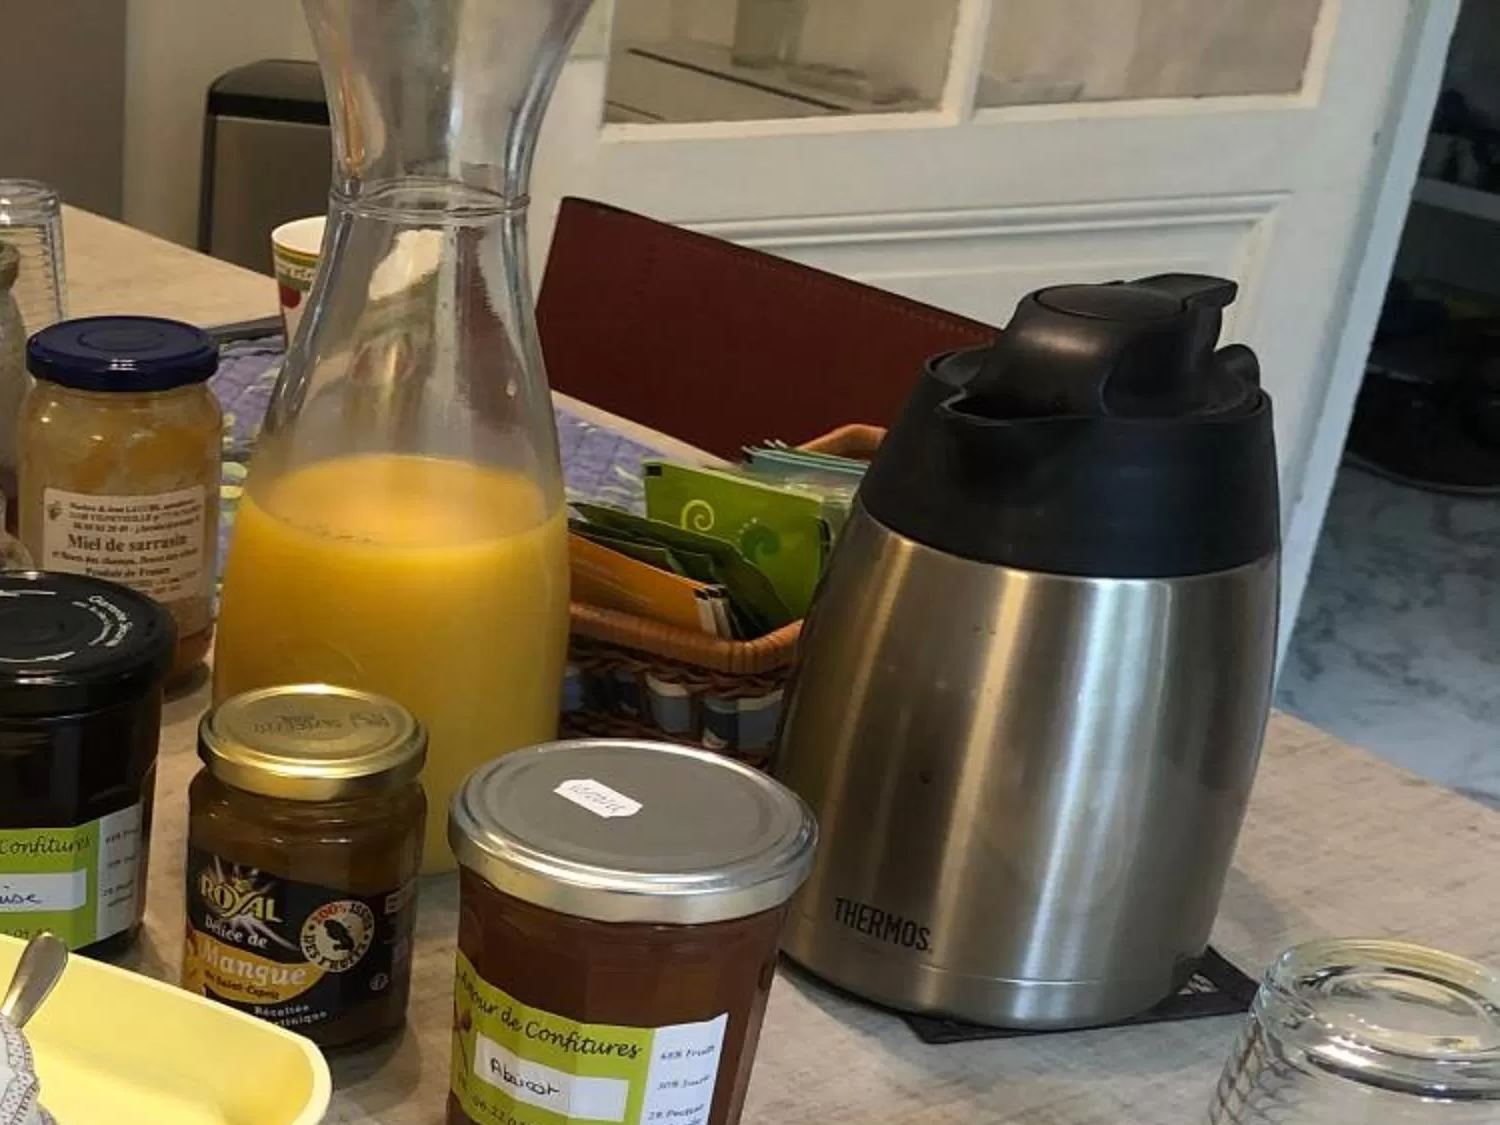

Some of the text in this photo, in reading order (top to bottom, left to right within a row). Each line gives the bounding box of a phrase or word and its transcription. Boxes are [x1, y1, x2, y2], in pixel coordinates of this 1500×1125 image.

[68, 532, 101, 551] Miel
[105, 535, 125, 553] de
[248, 932, 268, 949] de
[835, 897, 930, 951] THERMOS
[201, 938, 307, 987] Mangue
[501, 1006, 523, 1031] de
[525, 1020, 643, 1060] Confitures
